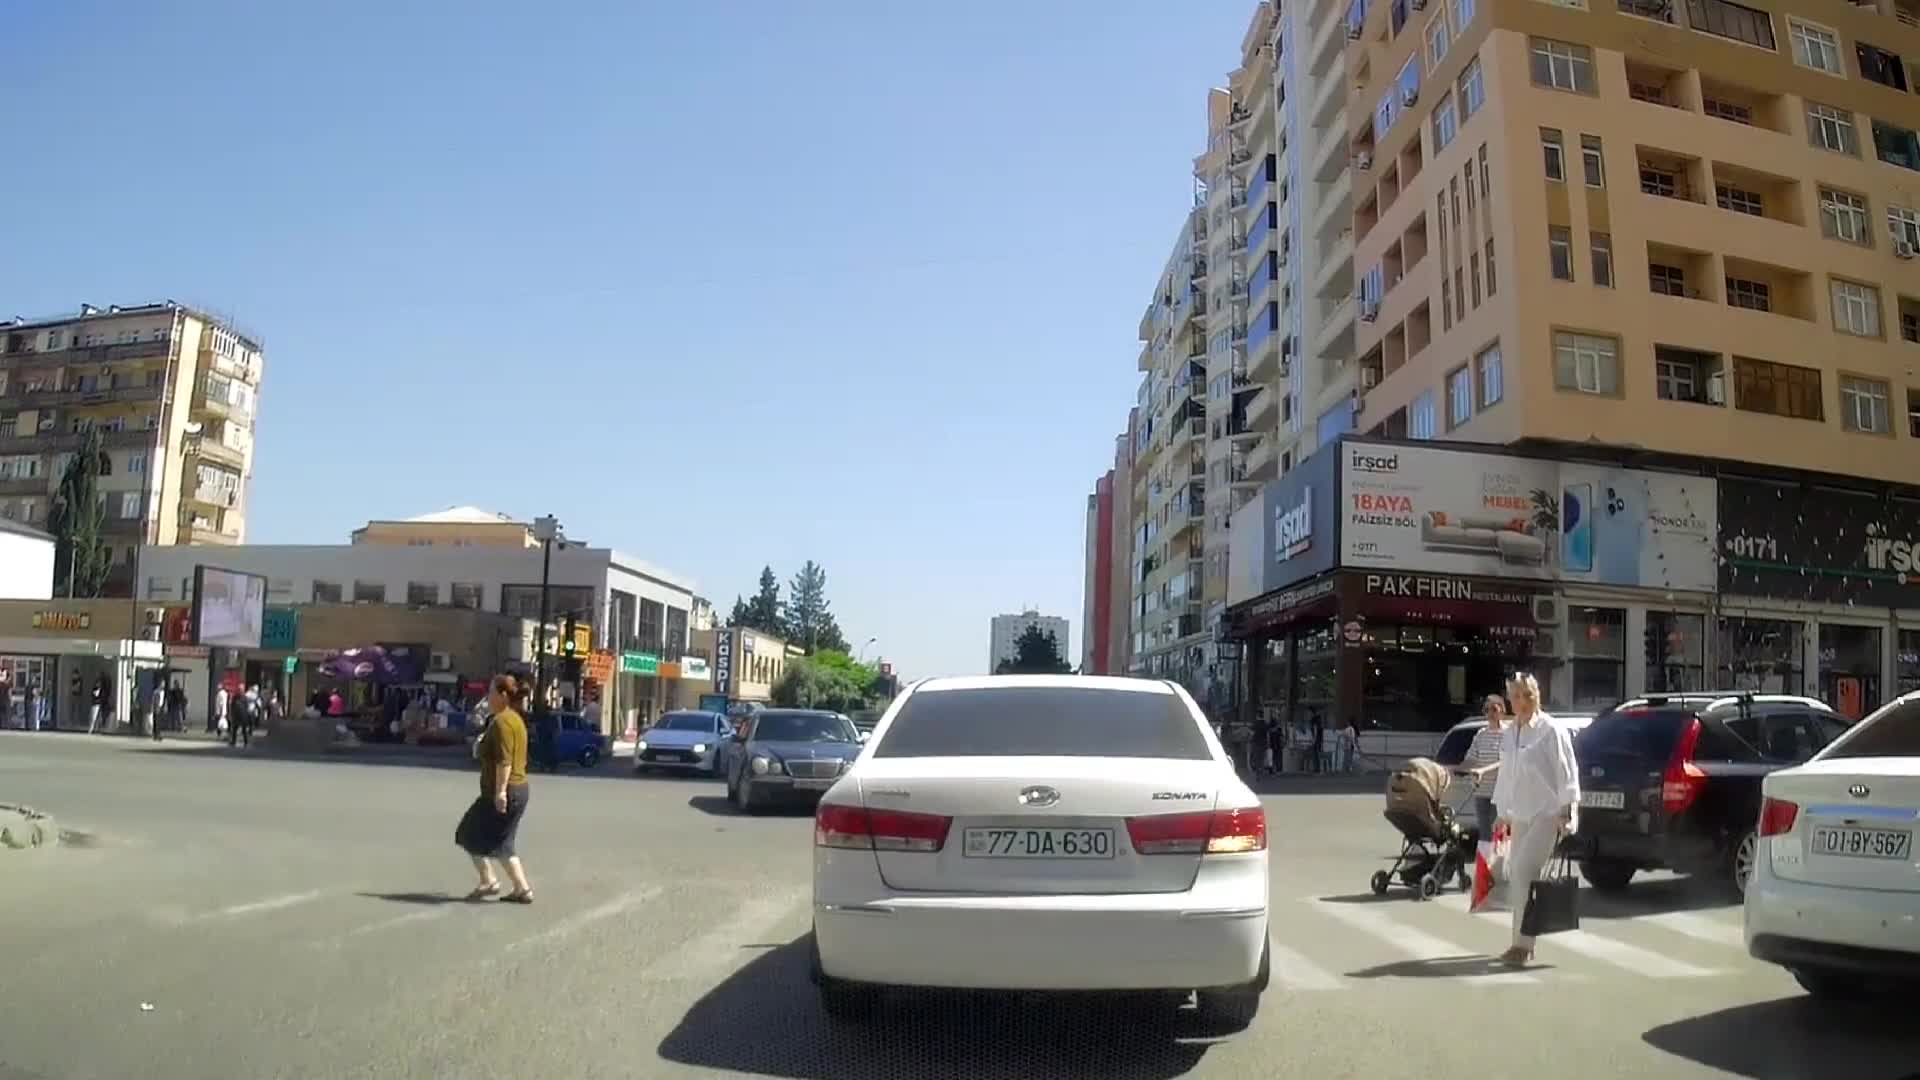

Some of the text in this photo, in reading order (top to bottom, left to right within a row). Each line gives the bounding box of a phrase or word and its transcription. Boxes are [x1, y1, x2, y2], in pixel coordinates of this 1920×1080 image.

[1352, 450, 1398, 472] irşad
[1366, 575, 1411, 595] PAK
[1151, 791, 1207, 800] SONATA
[988, 830, 1109, 856] 77-DA-630
[1827, 830, 1906, 856] 01-BY-567
